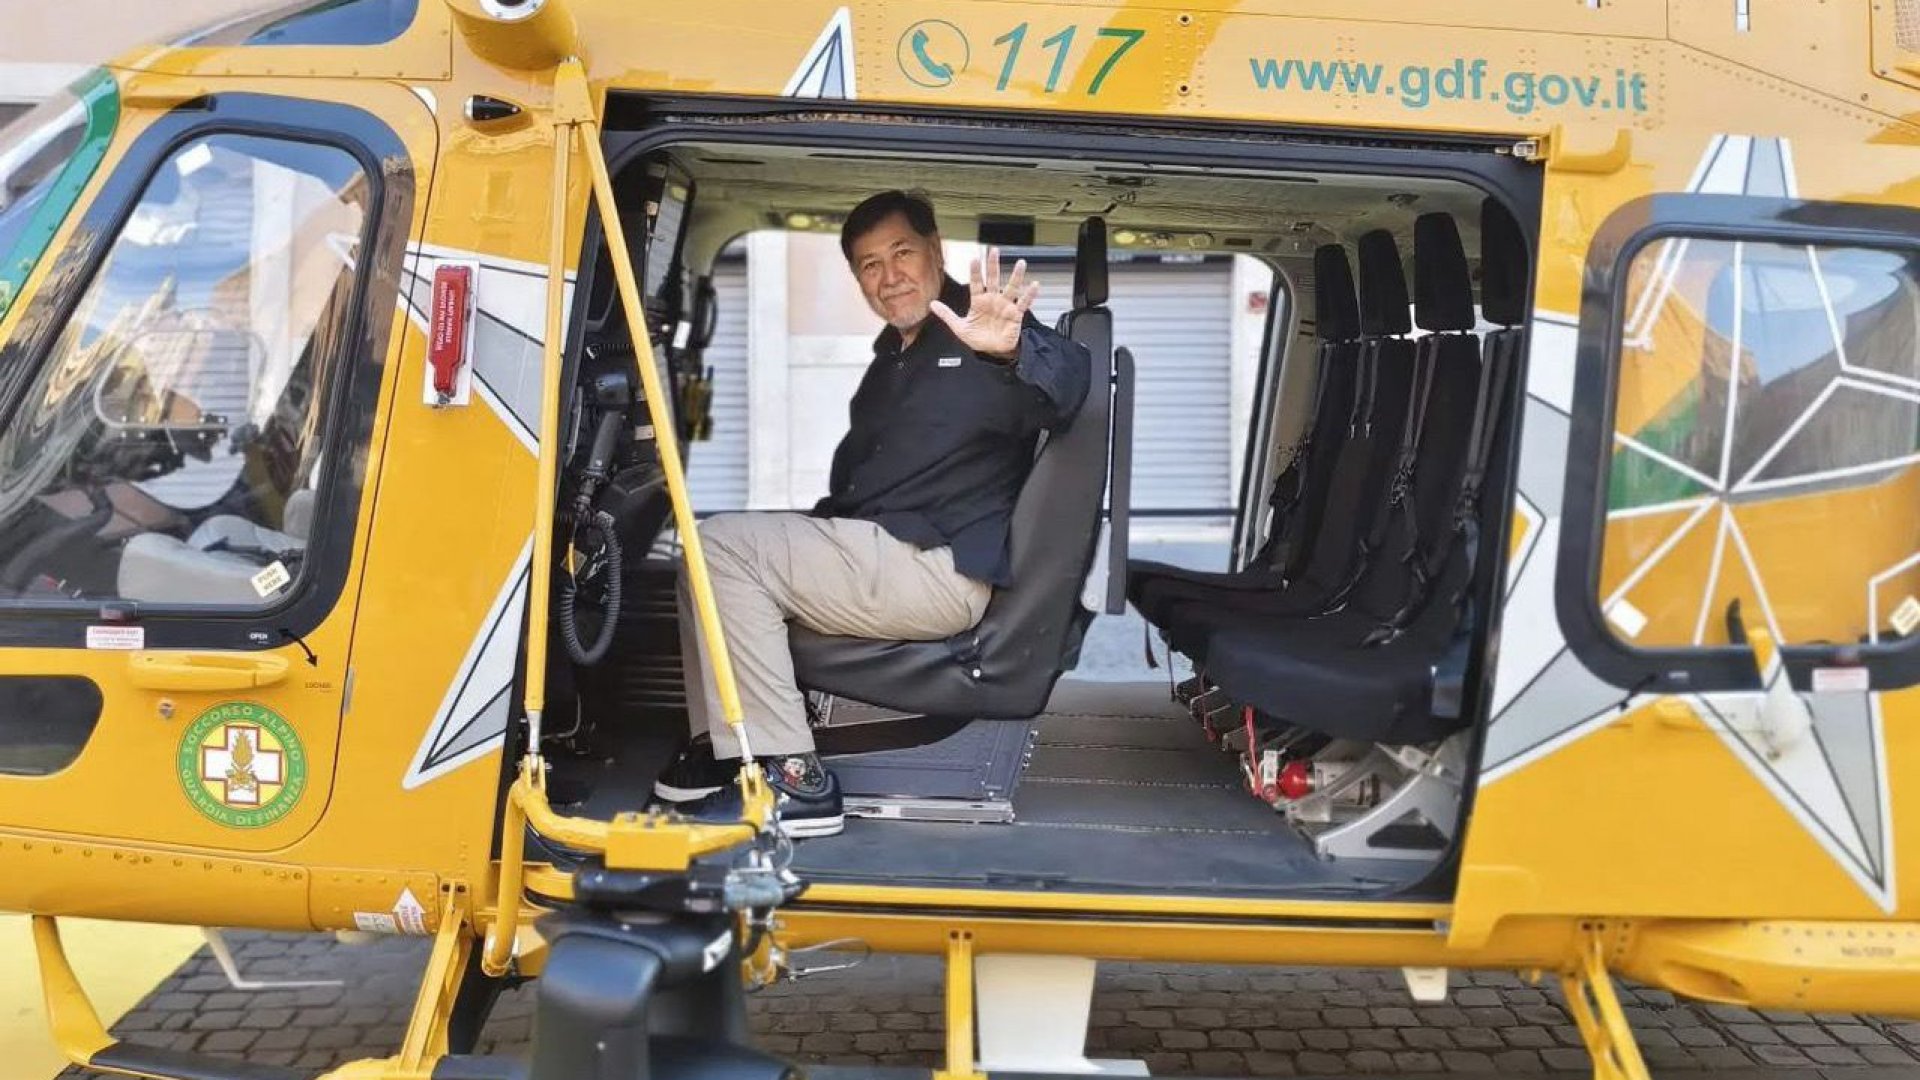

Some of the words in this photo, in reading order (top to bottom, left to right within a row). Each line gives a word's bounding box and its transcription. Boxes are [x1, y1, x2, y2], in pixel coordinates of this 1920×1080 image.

[994, 22, 1146, 96] 117
[1248, 56, 1648, 115] www.gdf.gov.it
[182, 706, 254, 754] SOCCORSO
[259, 711, 301, 761] ALPINO
[181, 768, 229, 822] GUARDIA
